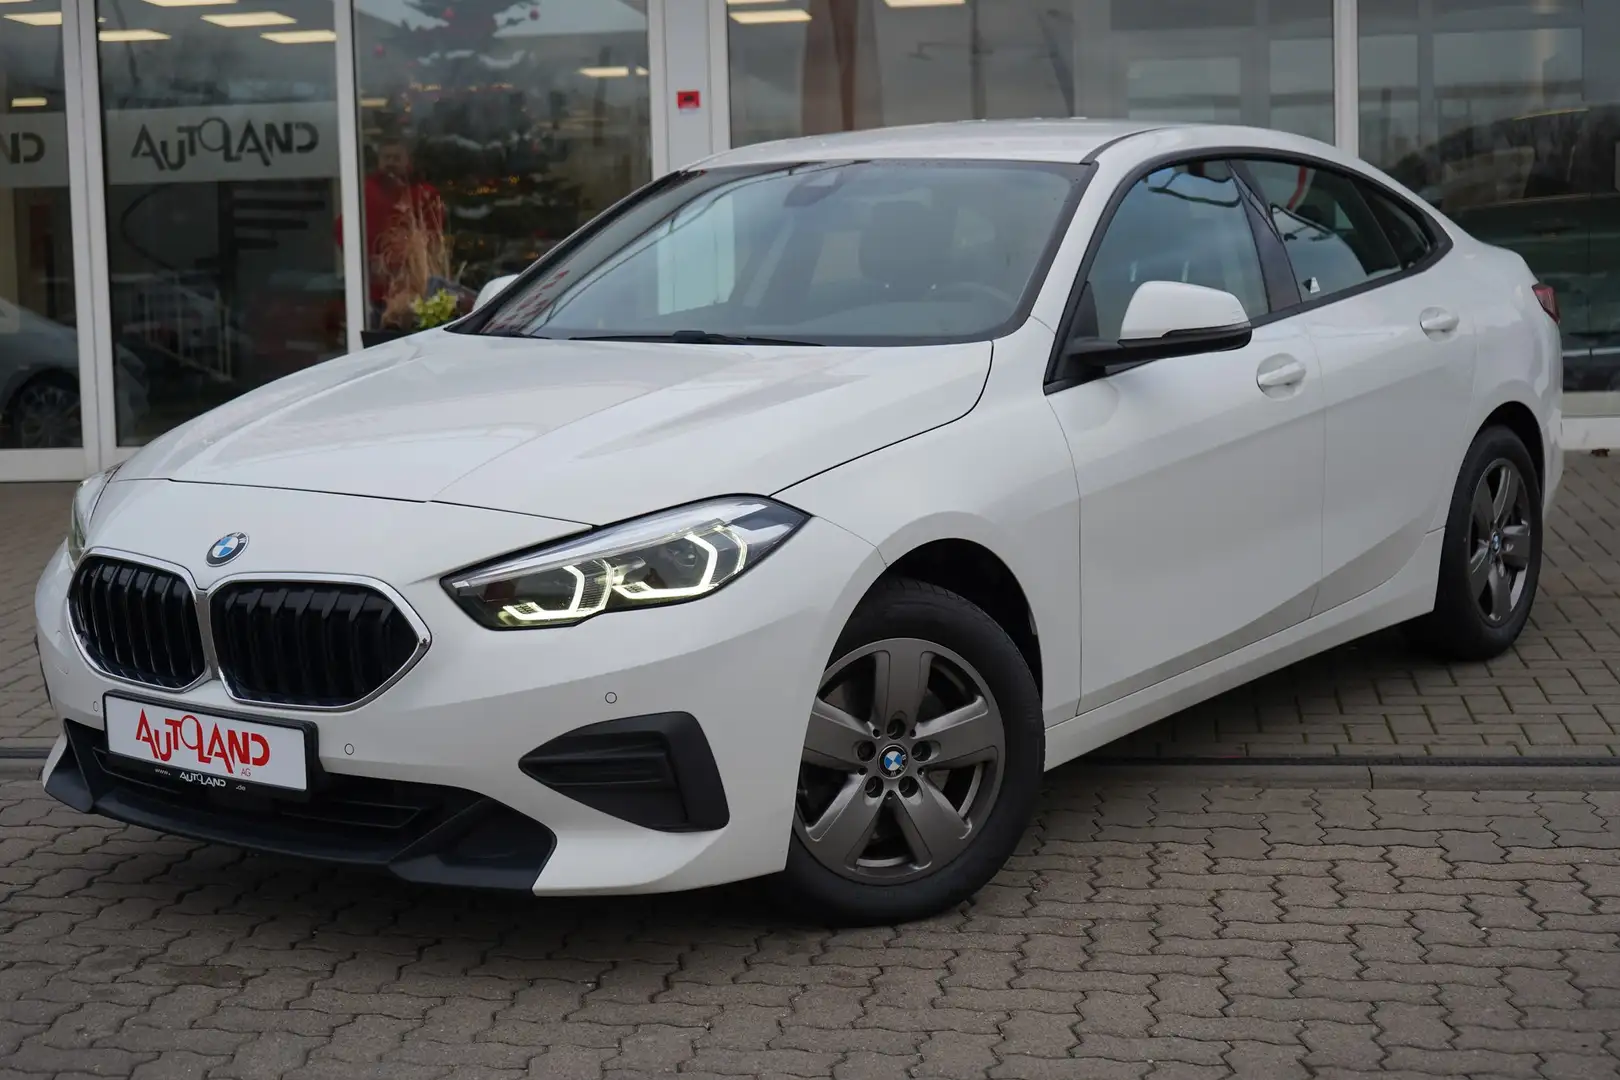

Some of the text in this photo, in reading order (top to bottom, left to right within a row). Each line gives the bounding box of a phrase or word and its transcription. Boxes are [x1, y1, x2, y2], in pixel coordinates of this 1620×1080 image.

[131, 117, 319, 171] AUTOLAND
[135, 708, 270, 774] AUTOLAND
[179, 771, 226, 788] AUTOLAND
[240, 767, 251, 777] AG
